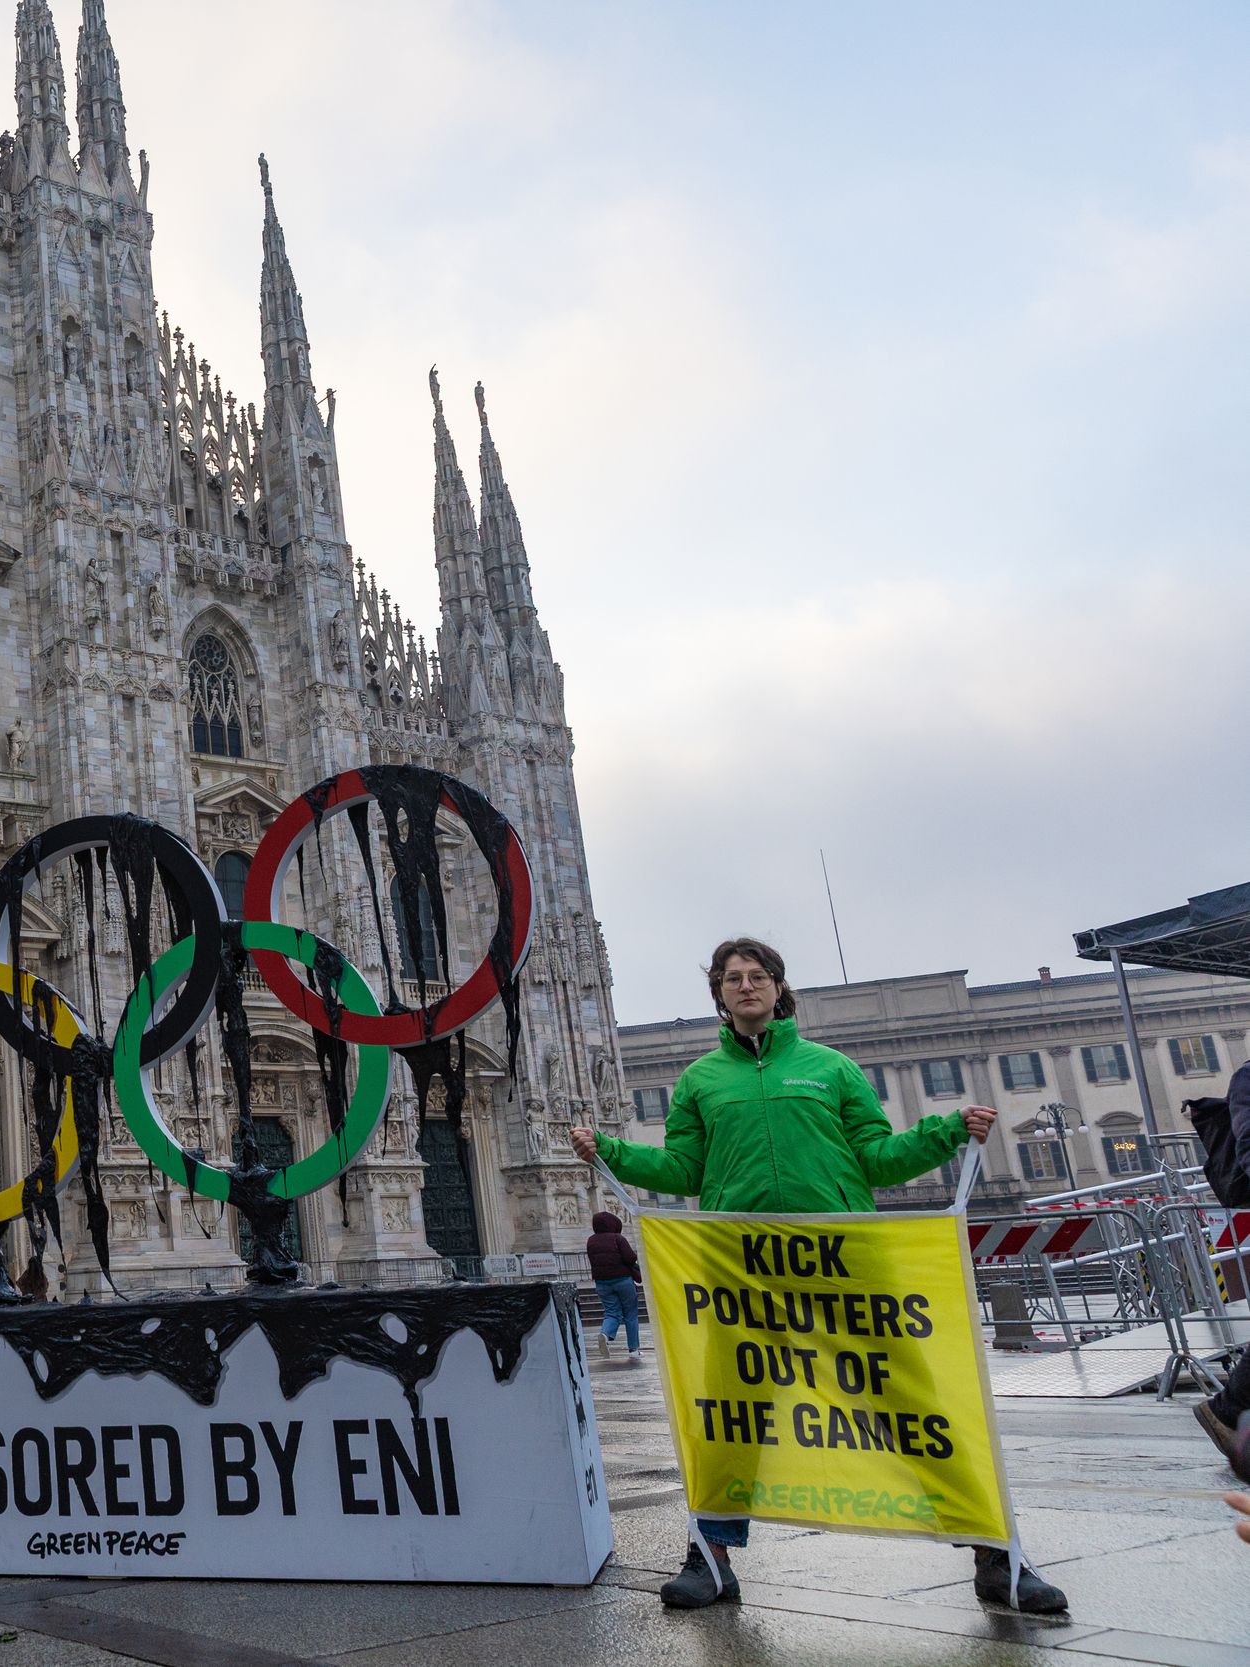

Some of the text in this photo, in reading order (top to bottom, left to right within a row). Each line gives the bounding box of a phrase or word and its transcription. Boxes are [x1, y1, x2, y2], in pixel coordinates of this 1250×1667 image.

[782, 1078, 829, 1089] GREENPEACE
[741, 1233, 851, 1278] KICK
[683, 1283, 934, 1338] POLLUTERS
[735, 1341, 891, 1395] OUT OF
[695, 1398, 954, 1460] THE GAMES
[209, 1420, 304, 1516] BY
[333, 1417, 461, 1516] ENI
[725, 1478, 945, 1523] GREENPEACE
[26, 1530, 187, 1560] GREENPEACE
